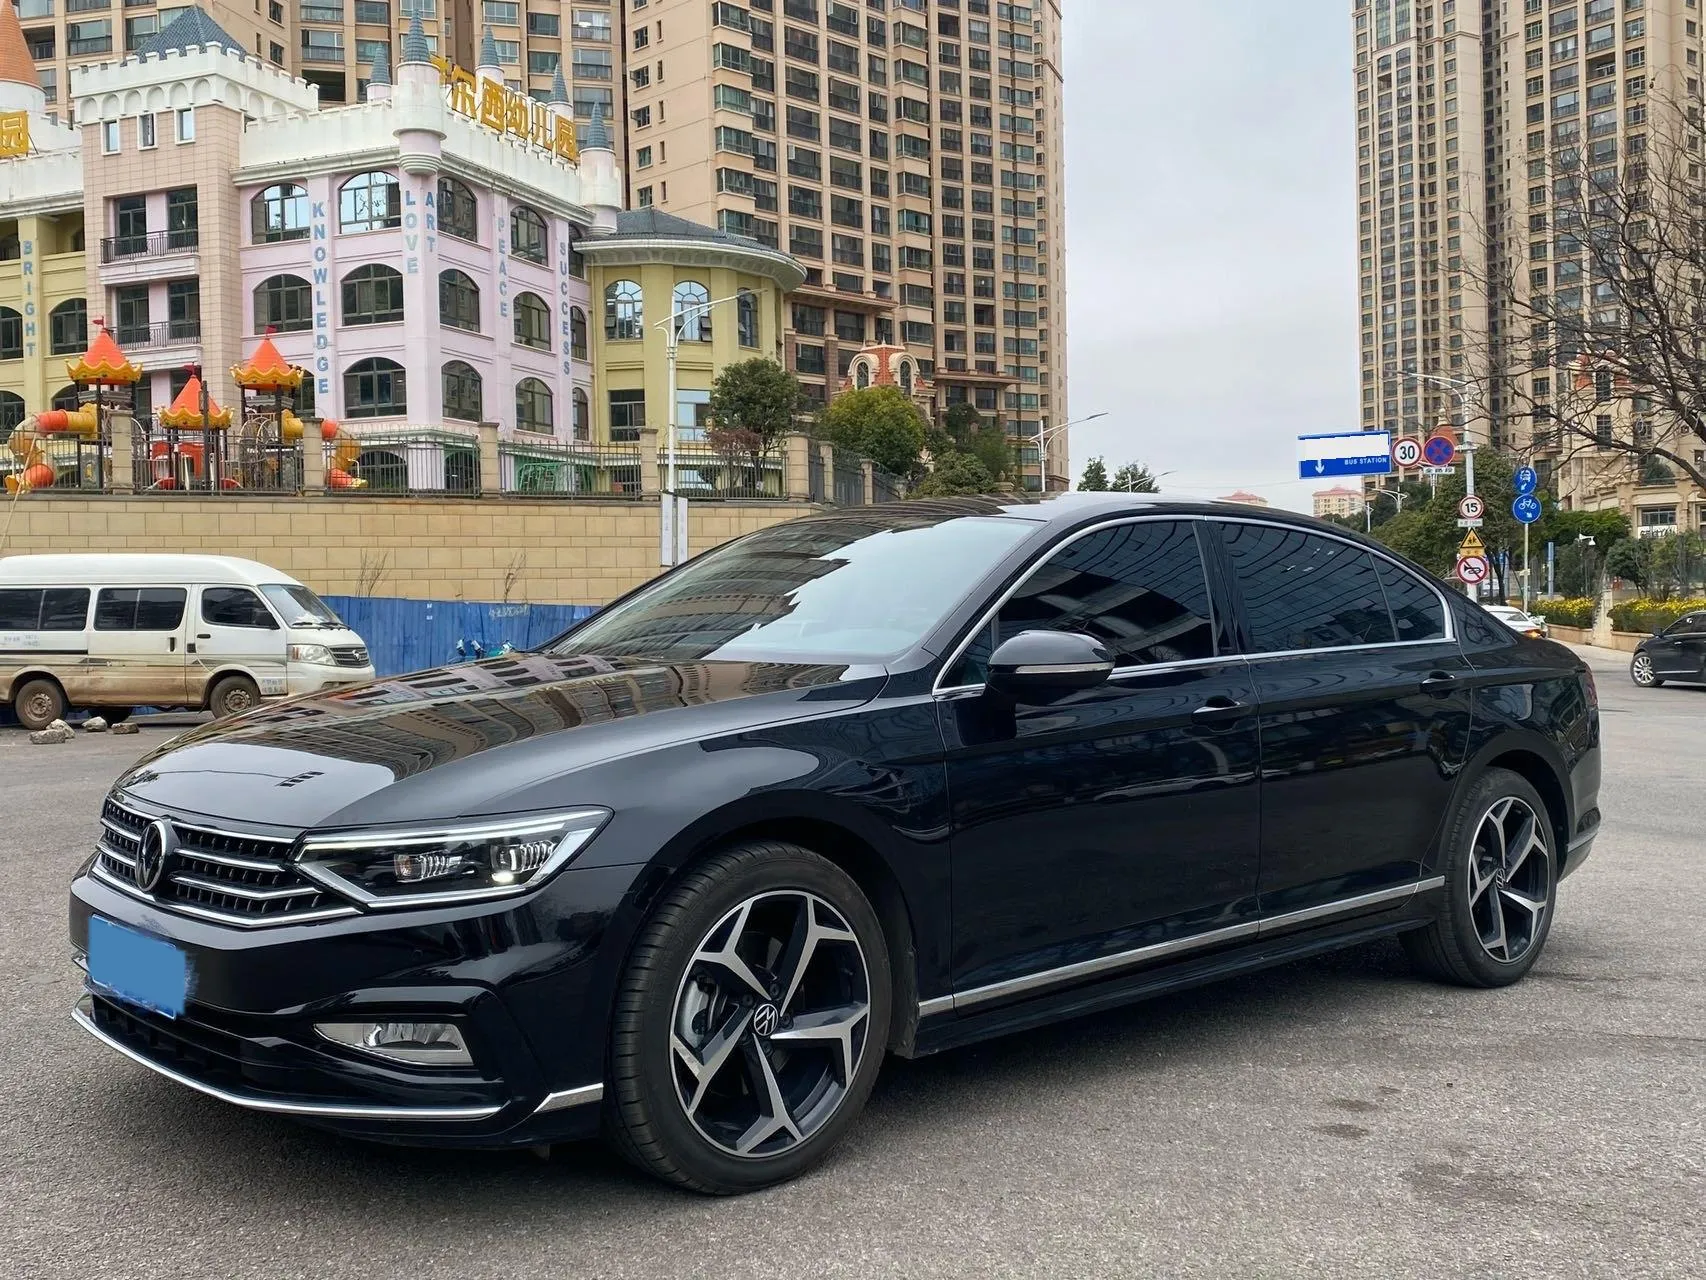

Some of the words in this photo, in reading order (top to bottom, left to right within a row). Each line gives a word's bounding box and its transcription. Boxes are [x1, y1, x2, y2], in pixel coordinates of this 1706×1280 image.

[405, 190, 419, 274] LOVE
[425, 191, 435, 253] ART
[23, 240, 36, 357] BRIGHT
[312, 201, 329, 395] KNOWLEDGE
[498, 216, 508, 318] PEACE
[559, 241, 571, 376] SUCCESS
[1344, 458, 1358, 466] BUS
[1359, 456, 1387, 465] STATION
[1400, 445, 1415, 460] 30
[1465, 502, 1478, 513] 15
